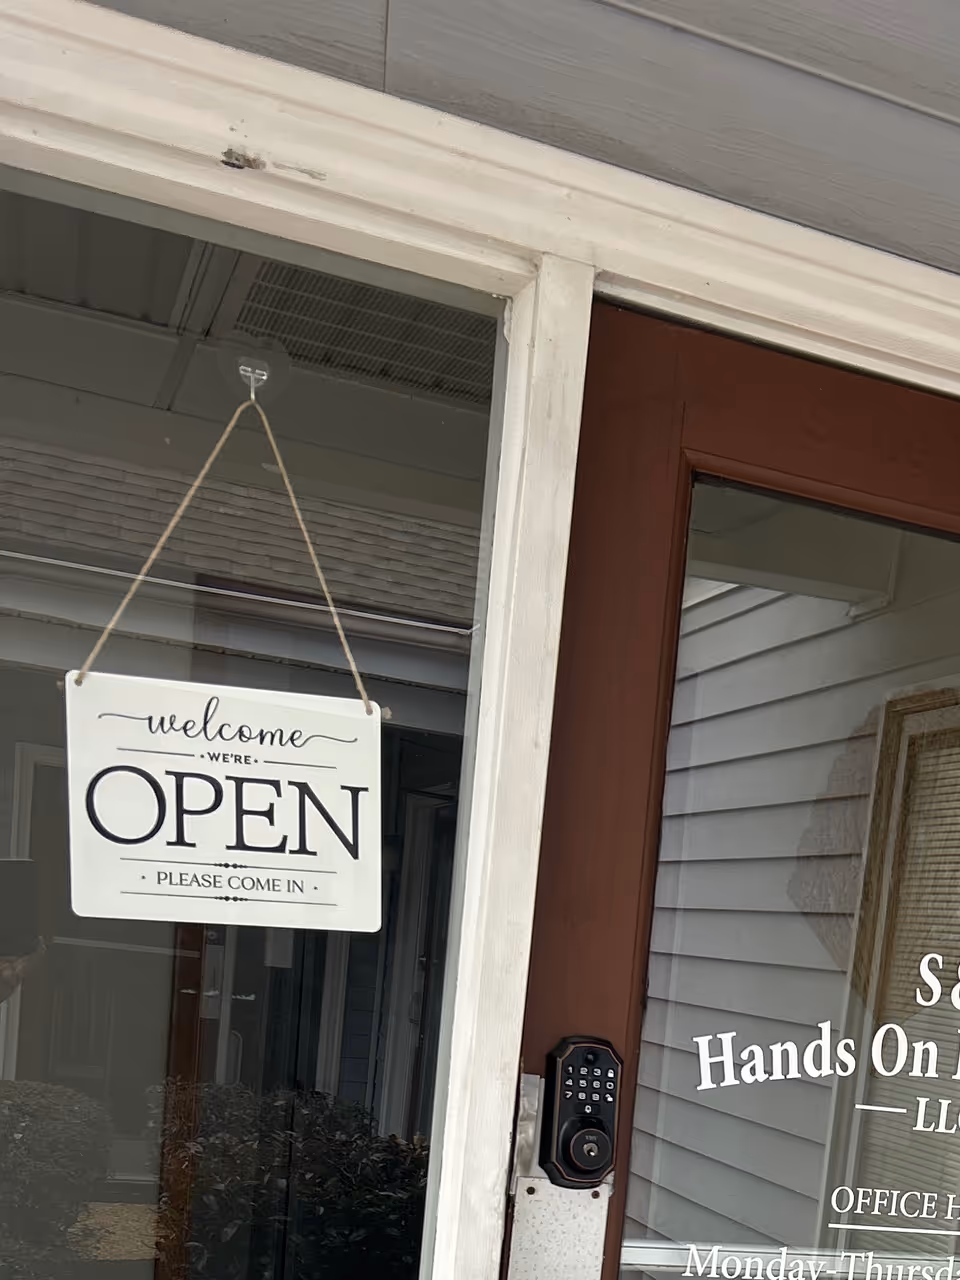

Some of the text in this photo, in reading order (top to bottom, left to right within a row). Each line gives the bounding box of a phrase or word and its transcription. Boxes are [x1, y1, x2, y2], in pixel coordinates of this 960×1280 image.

[98, 696, 358, 748] welcome
[85, 765, 369, 860] OPEN
[157, 872, 304, 893] PLEASE COME IN
[692, 1020, 856, 1091] Hands
[871, 1022, 939, 1078] On
[830, 1185, 938, 1219] OFFICE
